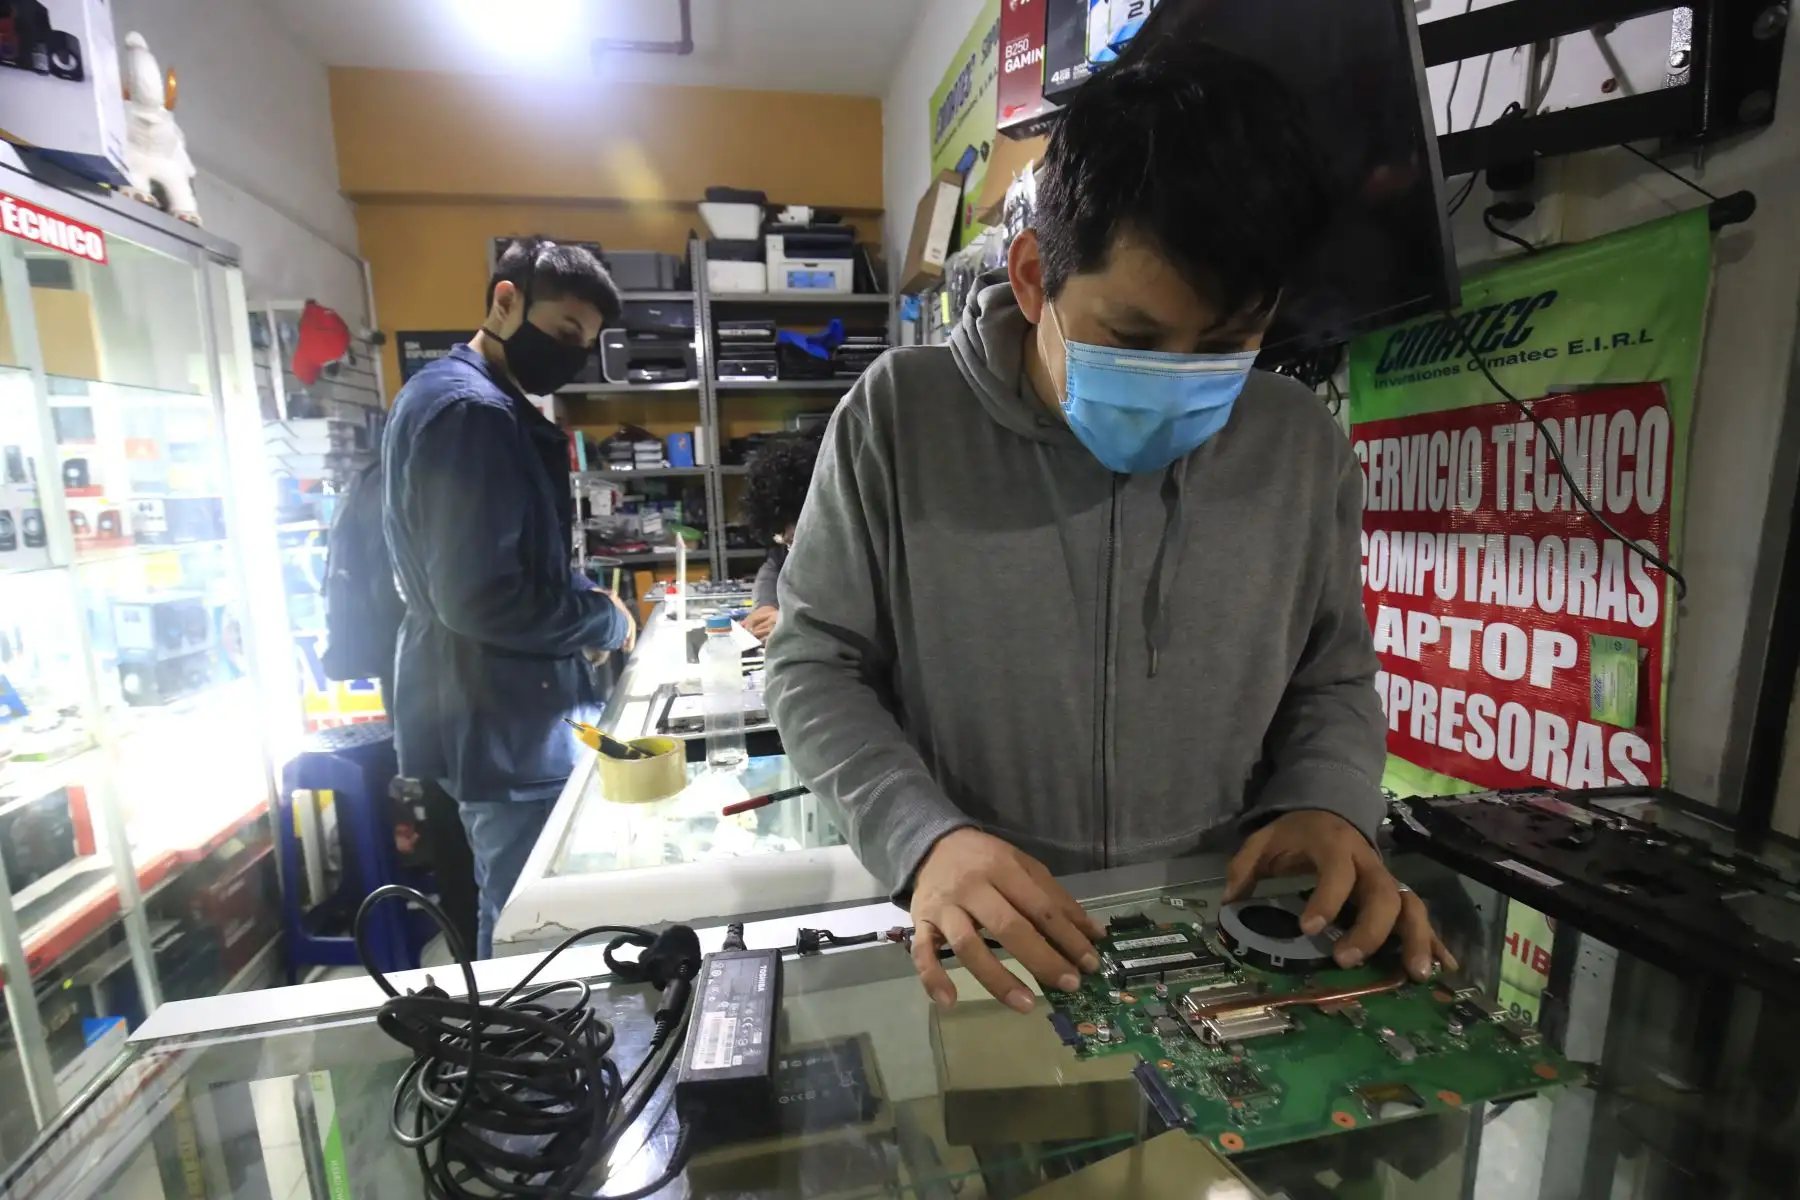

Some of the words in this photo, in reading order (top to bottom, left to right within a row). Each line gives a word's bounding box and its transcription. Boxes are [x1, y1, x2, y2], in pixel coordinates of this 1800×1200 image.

[1005, 38, 1029, 58] B250
[1005, 47, 1044, 73] GAMIN
[0, 197, 104, 261] ÉCNICO
[1354, 426, 1483, 513] SERVICIO
[1491, 402, 1671, 515] TÉCNICO
[1373, 604, 1578, 690] APTOP
[1374, 670, 1651, 790] PRESORAS
[757, 964, 768, 992] TOSHIBA
